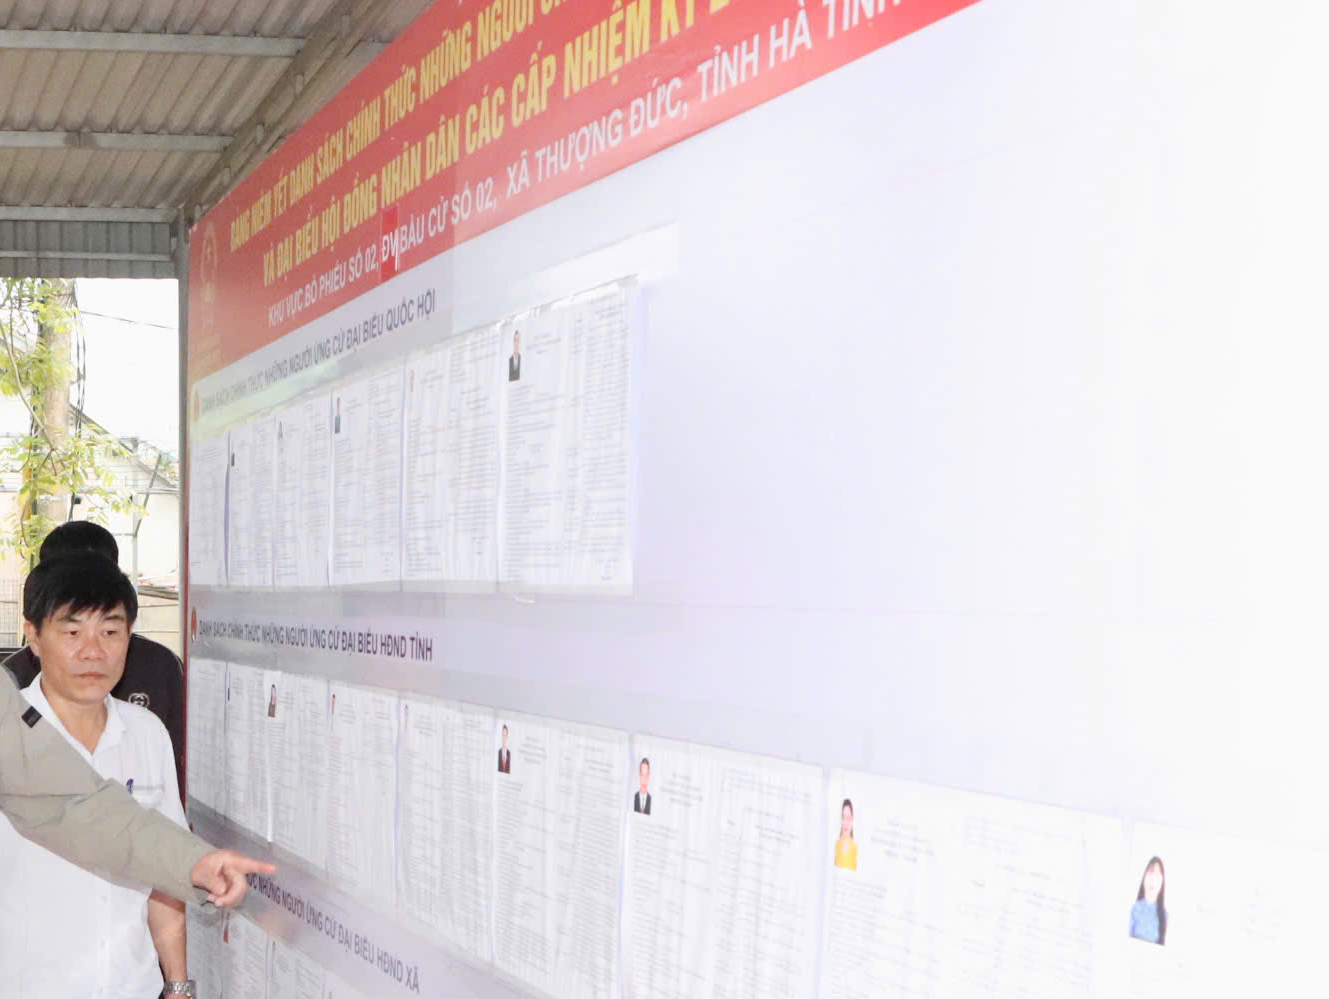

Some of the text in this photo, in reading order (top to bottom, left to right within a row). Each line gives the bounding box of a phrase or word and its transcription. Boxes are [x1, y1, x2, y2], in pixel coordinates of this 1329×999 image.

[277, 234, 293, 280] ĐẠI
[295, 204, 319, 266] BIỂU
[321, 195, 340, 252] HỘI
[343, 172, 377, 235] ĐỒNG
[381, 141, 421, 209] NHÂN
[425, 113, 460, 181] DÂN
[465, 84, 505, 155] CÁC
[511, 40, 557, 128] CẤP
[563, 0, 651, 100] NHIỆM
[290, 153, 313, 208] DANH
[317, 127, 343, 184] SÁCH
[346, 95, 381, 161] CHÍNH
[383, 64, 417, 131] THỨC
[421, 20, 472, 104] NHỮNG
[319, 259, 347, 299] PHIẾU
[349, 245, 363, 282] SỐ
[428, 196, 449, 237] CỬ
[451, 180, 472, 226] SỐ
[476, 176, 497, 212] 02,
[506, 148, 530, 198] XÃ
[535, 108, 623, 182] THƯỢNG
[630, 76, 688, 137] ĐỨC,
[697, 33, 760, 102] TỈNH
[768, 0, 812, 68] HÀ
[332, 327, 345, 355] CỬ
[346, 323, 361, 352] ĐẠI
[362, 311, 384, 343] BIỂU
[385, 296, 414, 331] QUỐC
[417, 287, 435, 320] HỘI
[285, 623, 308, 647] NGƯỜI
[309, 622, 326, 649] ỨNG
[327, 625, 340, 651] CỬ
[341, 629, 356, 656] ĐẠI
[357, 626, 377, 655] BIỂU
[380, 635, 407, 658] HĐND
[409, 630, 433, 661] TỈNH
[338, 924, 352, 953] ĐẠI
[354, 933, 374, 964] BIỂU
[376, 950, 404, 984] HĐND
[406, 964, 420, 993] XÃ
